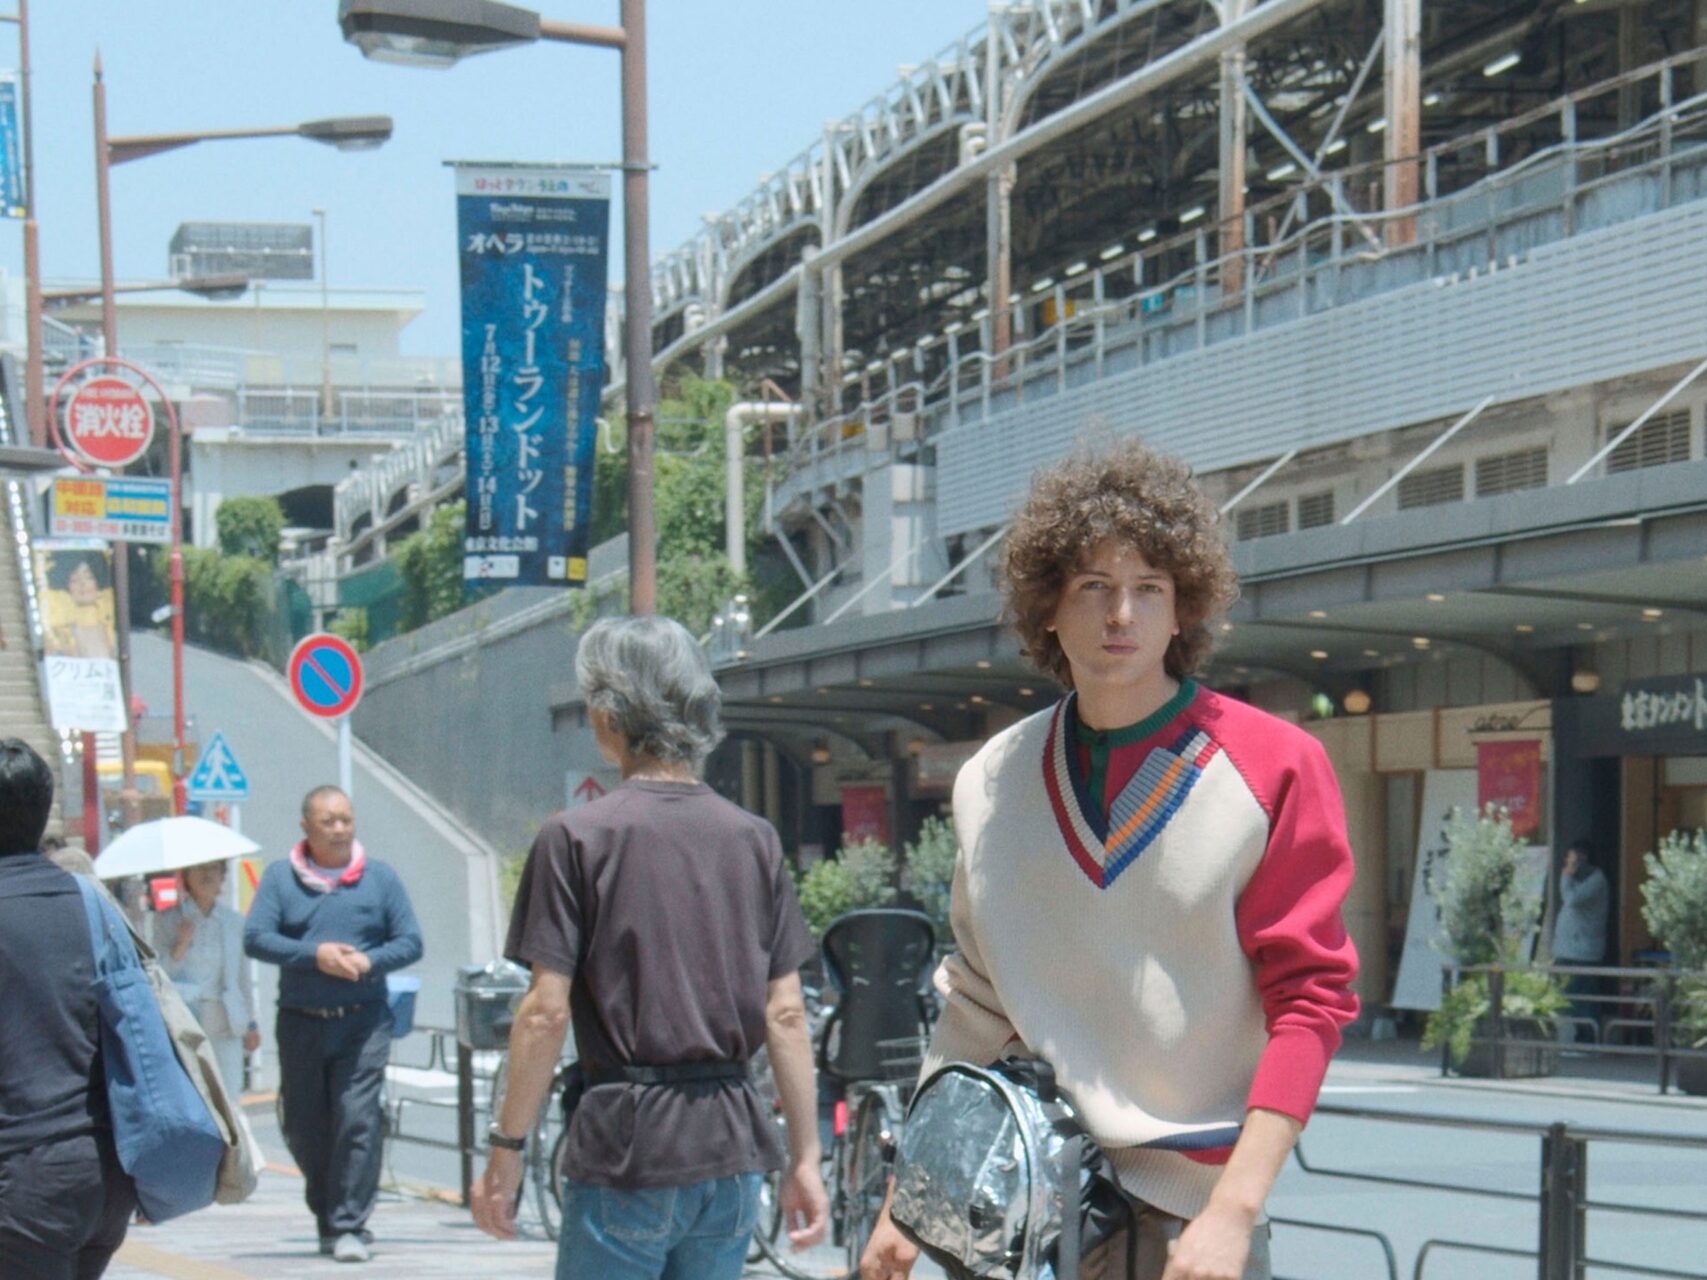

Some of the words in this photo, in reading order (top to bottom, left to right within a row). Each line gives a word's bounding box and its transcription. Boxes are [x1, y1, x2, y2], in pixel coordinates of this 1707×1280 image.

[467, 232, 525, 255] オペラ
[512, 262, 549, 531] トゥーランドット
[75, 403, 146, 438] 消火栓
[51, 659, 113, 680] クリムト
